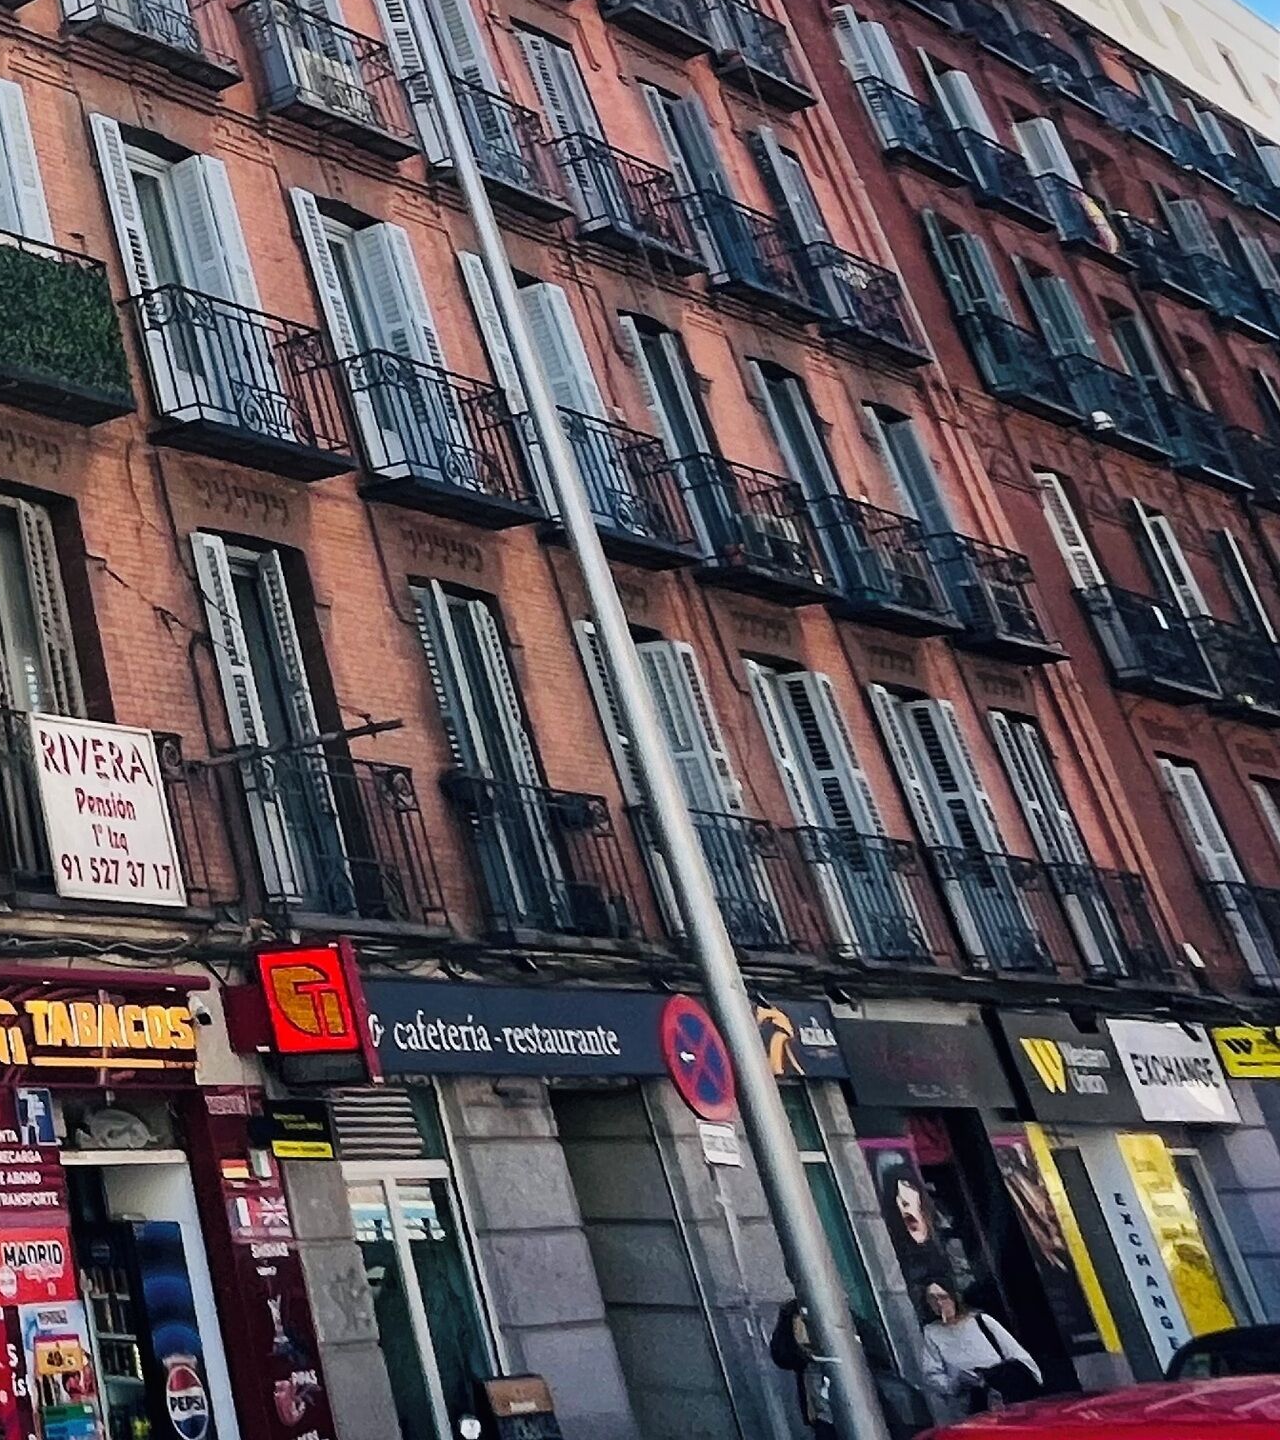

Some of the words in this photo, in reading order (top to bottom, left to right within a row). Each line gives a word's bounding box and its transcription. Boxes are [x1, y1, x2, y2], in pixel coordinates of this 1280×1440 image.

[39, 730, 154, 787] RIVERA
[75, 788, 137, 820] Pensión
[61, 853, 83, 881] 91
[90, 857, 120, 885] 527
[126, 861, 145, 888] 37
[152, 863, 171, 891] 17
[24, 999, 196, 1050] TABACOS
[1130, 1052, 1220, 1088] EXCHANGE
[7, 1170, 42, 1185] ABONO
[3, 1242, 63, 1268] MADRID
[169, 1395, 206, 1413] PEPSI
